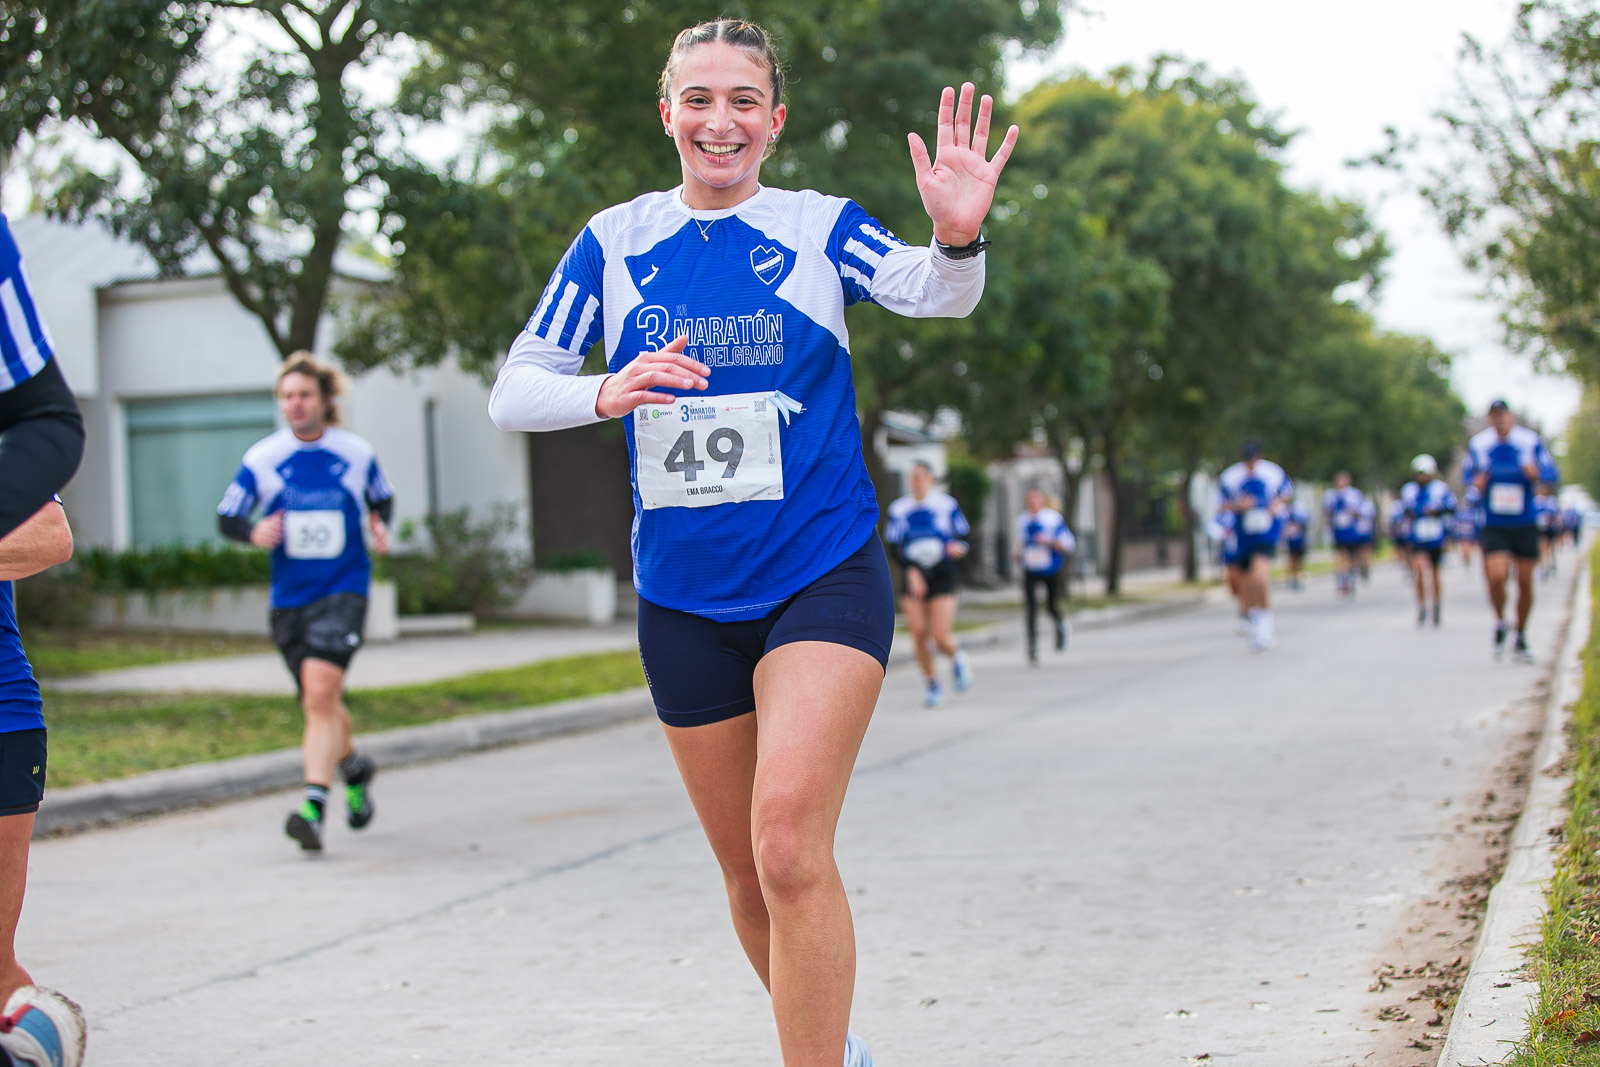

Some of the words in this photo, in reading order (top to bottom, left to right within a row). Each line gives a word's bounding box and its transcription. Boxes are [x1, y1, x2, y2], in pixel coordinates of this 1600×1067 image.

[636, 305, 669, 353] 3
[673, 308, 783, 347] MARATÓN
[703, 344, 784, 367] BELGRANO
[681, 404, 689, 423] 3
[690, 406, 716, 415] MARATÓN
[664, 427, 744, 482] 49
[687, 487, 700, 496] EMA
[701, 485, 724, 495] BRACCO
